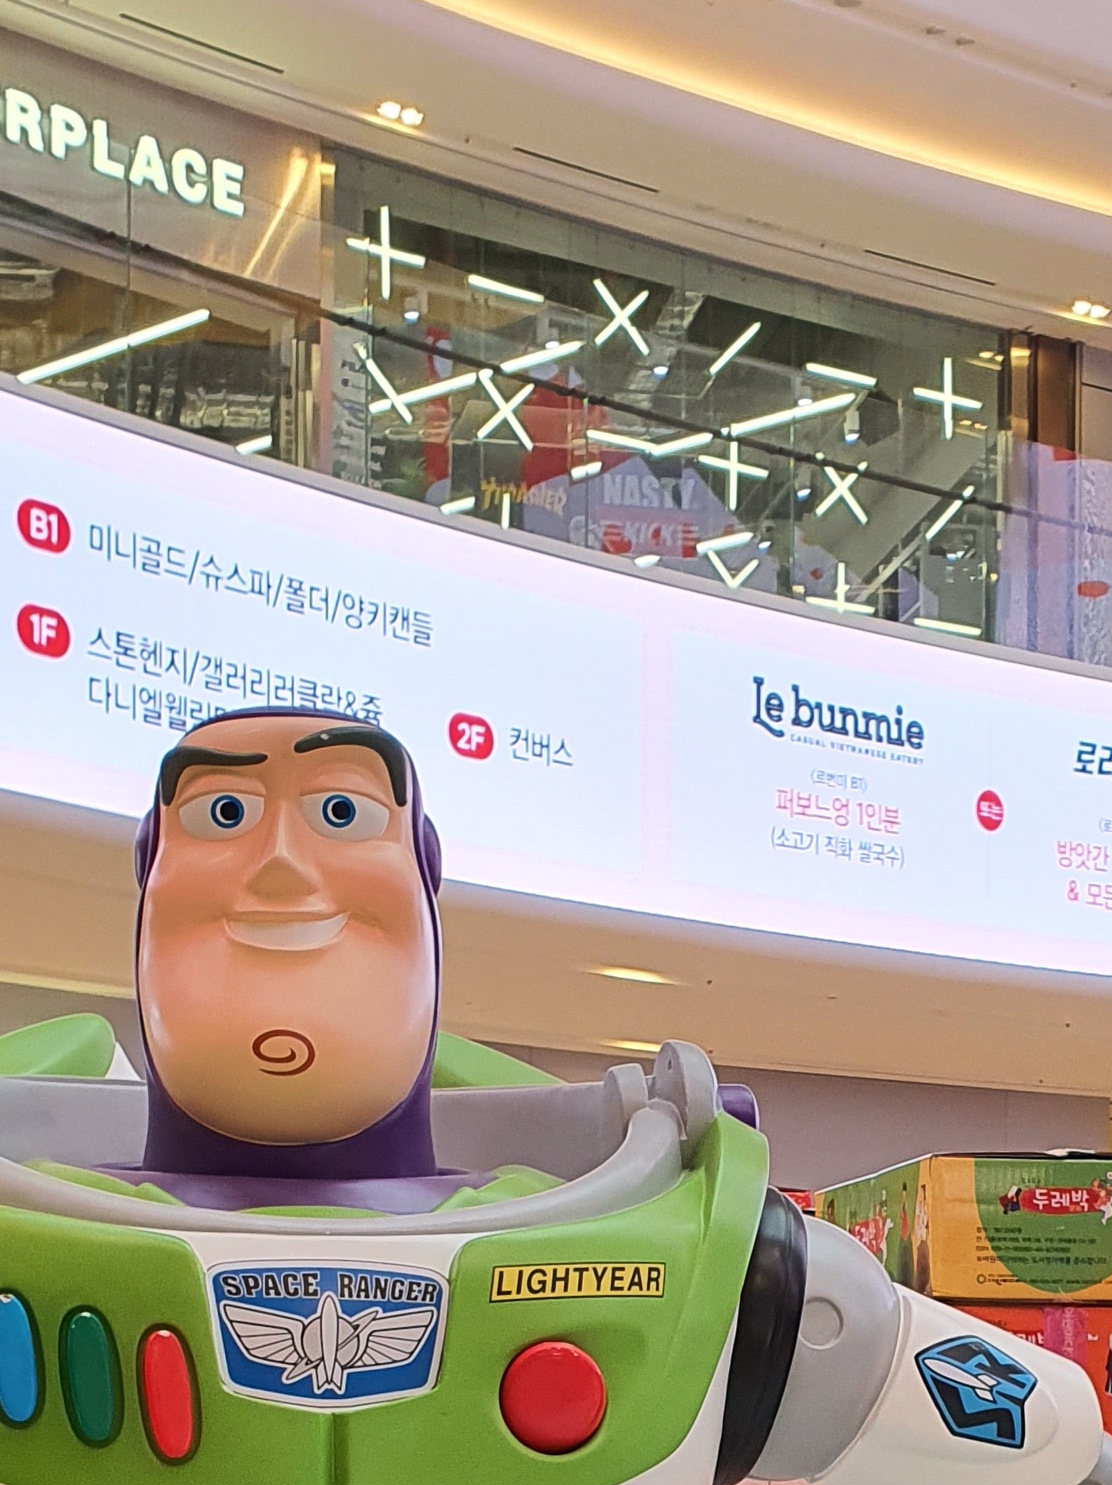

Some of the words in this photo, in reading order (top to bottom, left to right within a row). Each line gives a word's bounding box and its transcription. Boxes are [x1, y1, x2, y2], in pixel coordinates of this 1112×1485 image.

[5, 87, 245, 218] RPLACE
[30, 507, 58, 545] B1
[29, 612, 58, 648] 1F
[88, 675, 227, 732] 다니엘웰링
[456, 721, 486, 752] 2F
[508, 726, 575, 767] 컨버스
[775, 788, 850, 827] 퍼보느엉
[856, 802, 902, 835] 1인분
[771, 825, 820, 856] (소고기
[824, 835, 853, 861] 직화
[858, 840, 905, 870] 쌀국수)
[1056, 840, 1110, 872] 방앗간
[1067, 880, 1080, 901] &
[1033, 1188, 1089, 1212] 두레박
[221, 1271, 321, 1300] SPACE
[338, 1272, 439, 1304] RANGER
[496, 1266, 663, 1296] LIGHTYEAR
